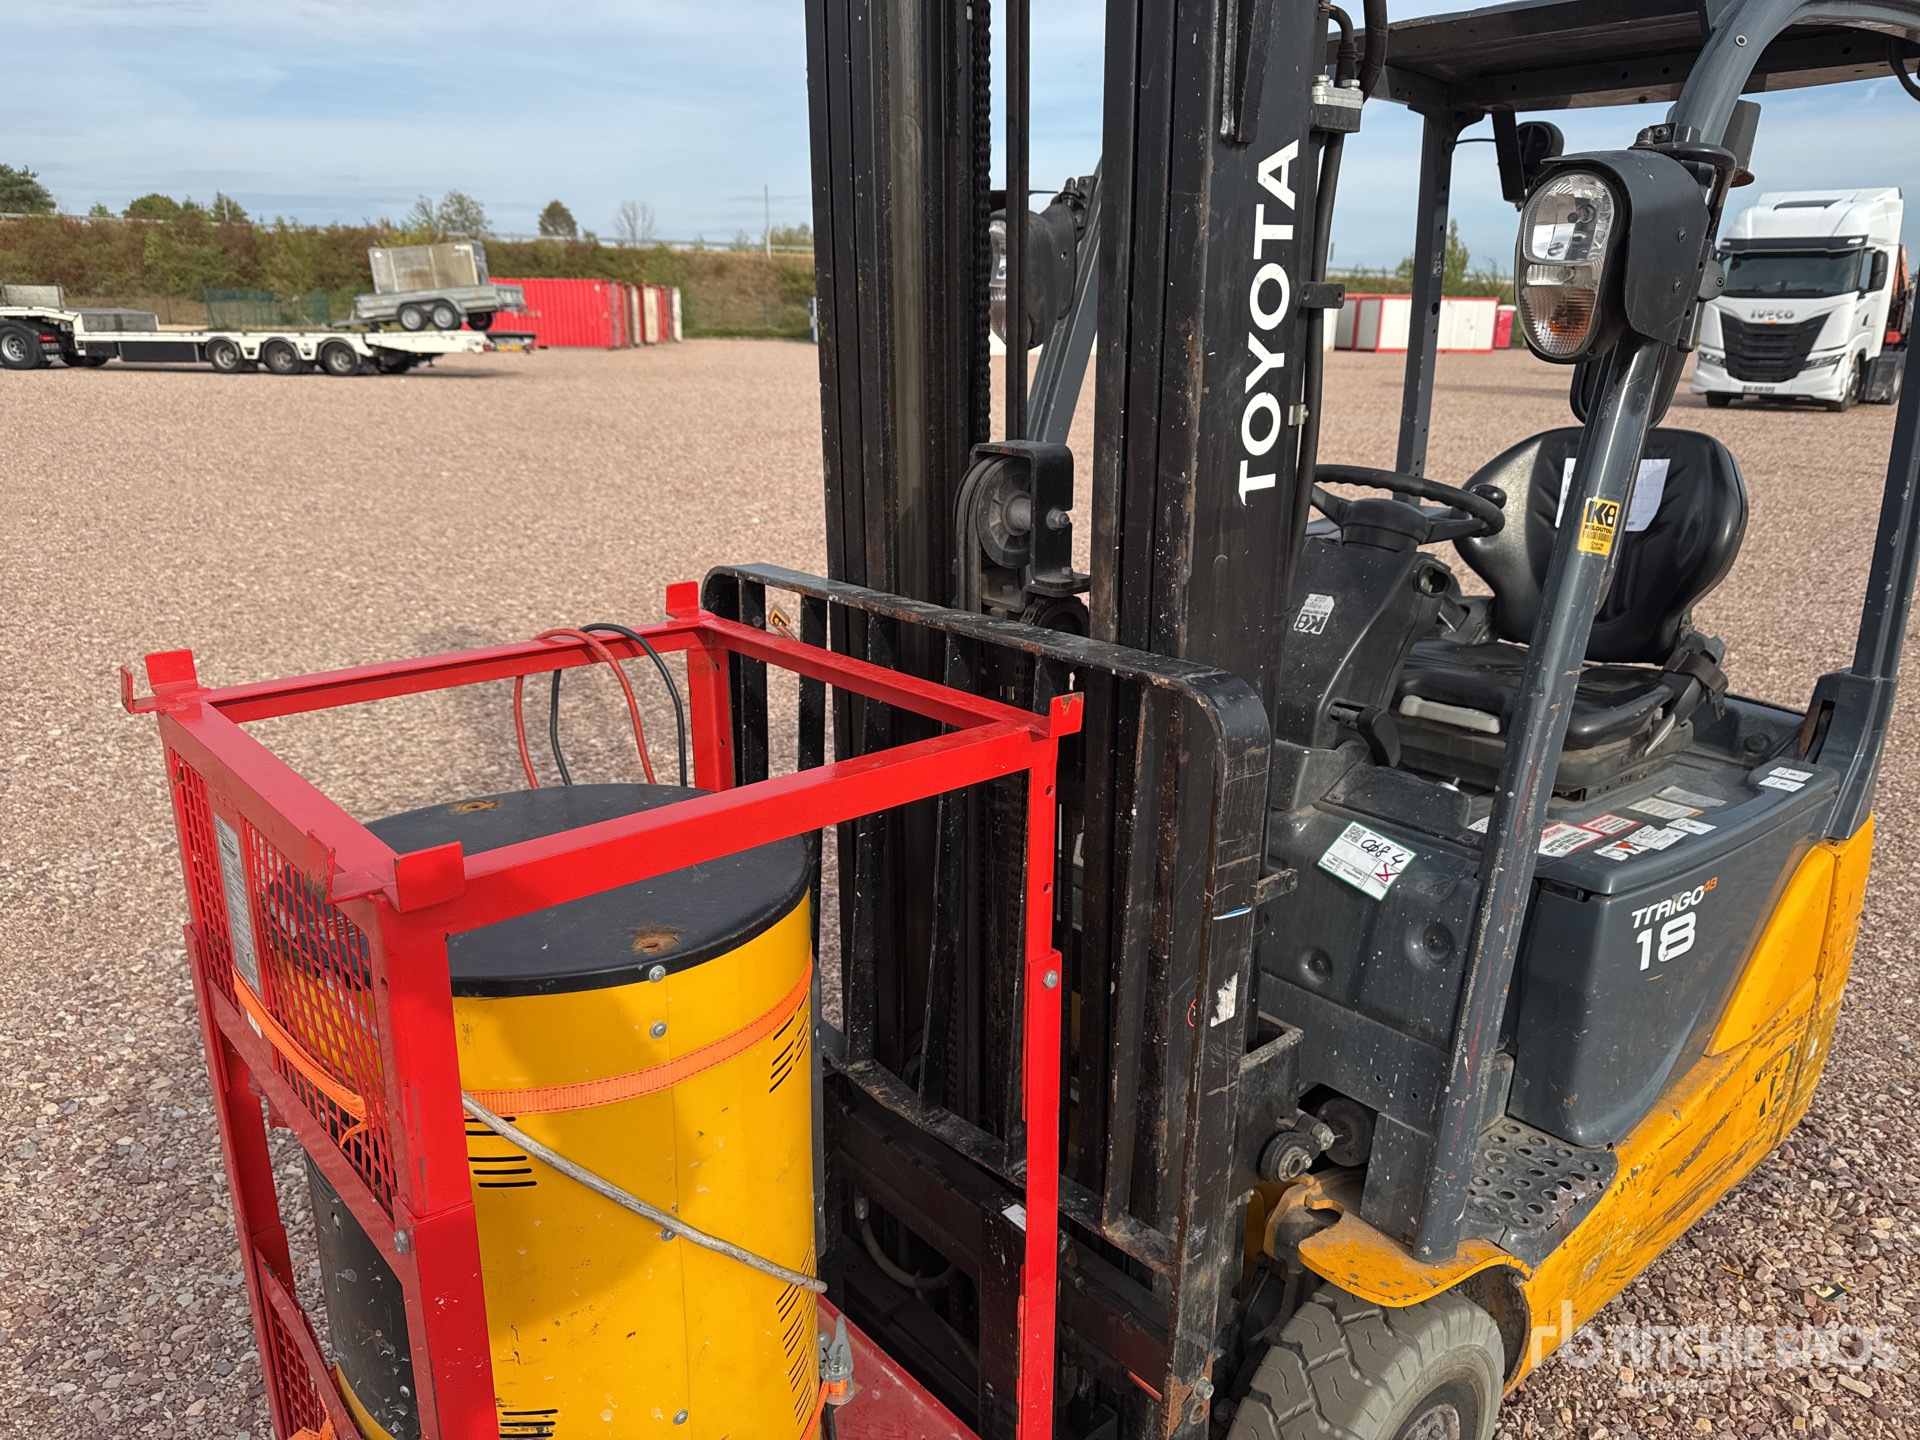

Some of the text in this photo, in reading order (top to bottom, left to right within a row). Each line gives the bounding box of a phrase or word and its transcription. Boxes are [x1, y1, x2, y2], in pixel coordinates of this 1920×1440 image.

[1238, 138, 1299, 506] TOYOTA
[1751, 309, 1794, 320] IVECO
[1636, 911, 1697, 972] 18
